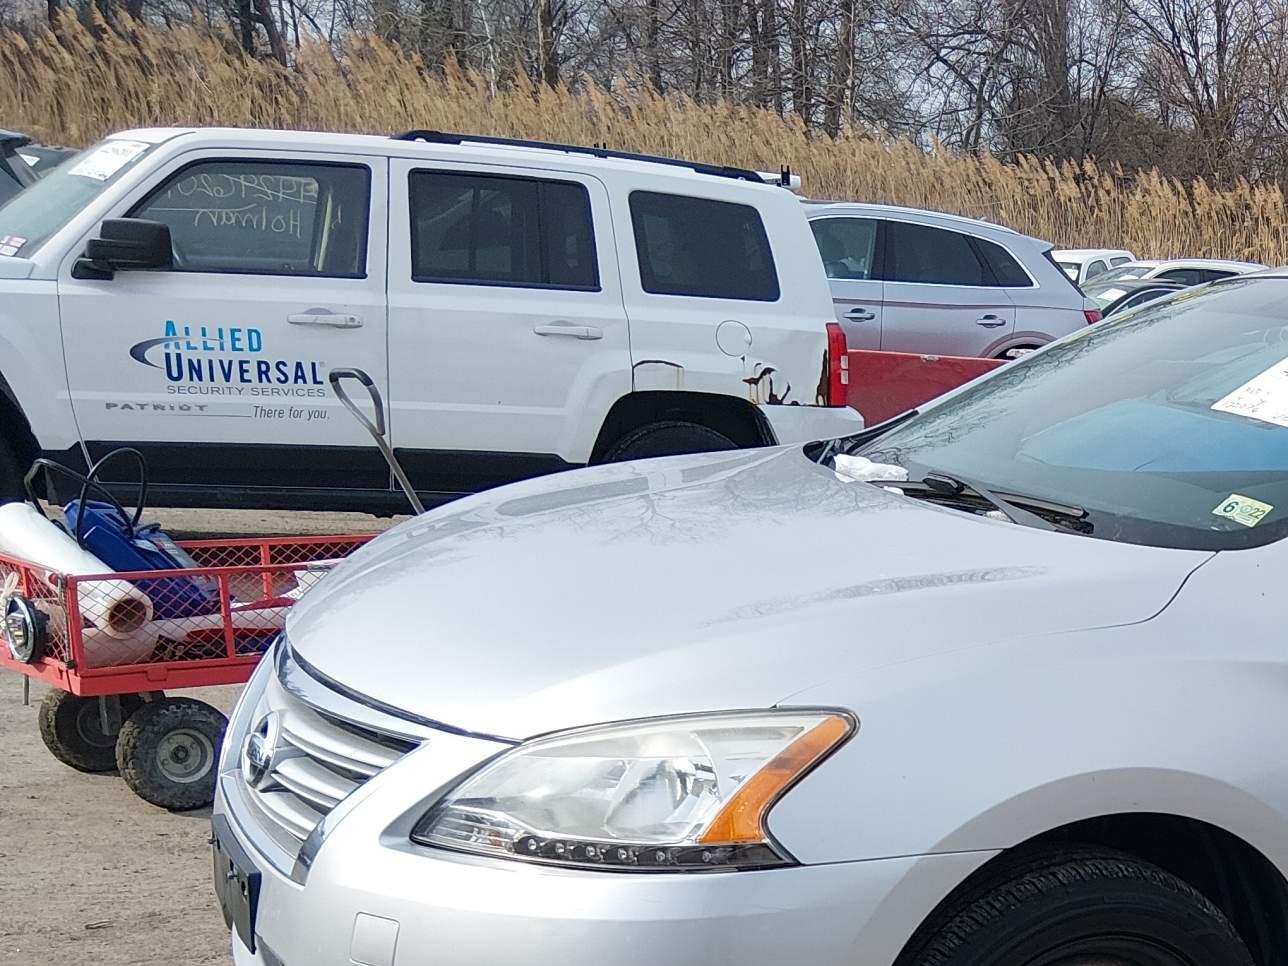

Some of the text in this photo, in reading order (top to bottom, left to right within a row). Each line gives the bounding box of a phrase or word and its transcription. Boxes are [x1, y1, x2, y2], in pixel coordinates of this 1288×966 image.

[164, 320, 262, 352] ALLIED
[164, 352, 324, 385] UNIVERSAL
[167, 385, 325, 397] SECURITY SERVICES
[105, 402, 209, 412] PATRIOT
[253, 405, 330, 422] There for you.
[1223, 501, 1267, 520] 6 22
